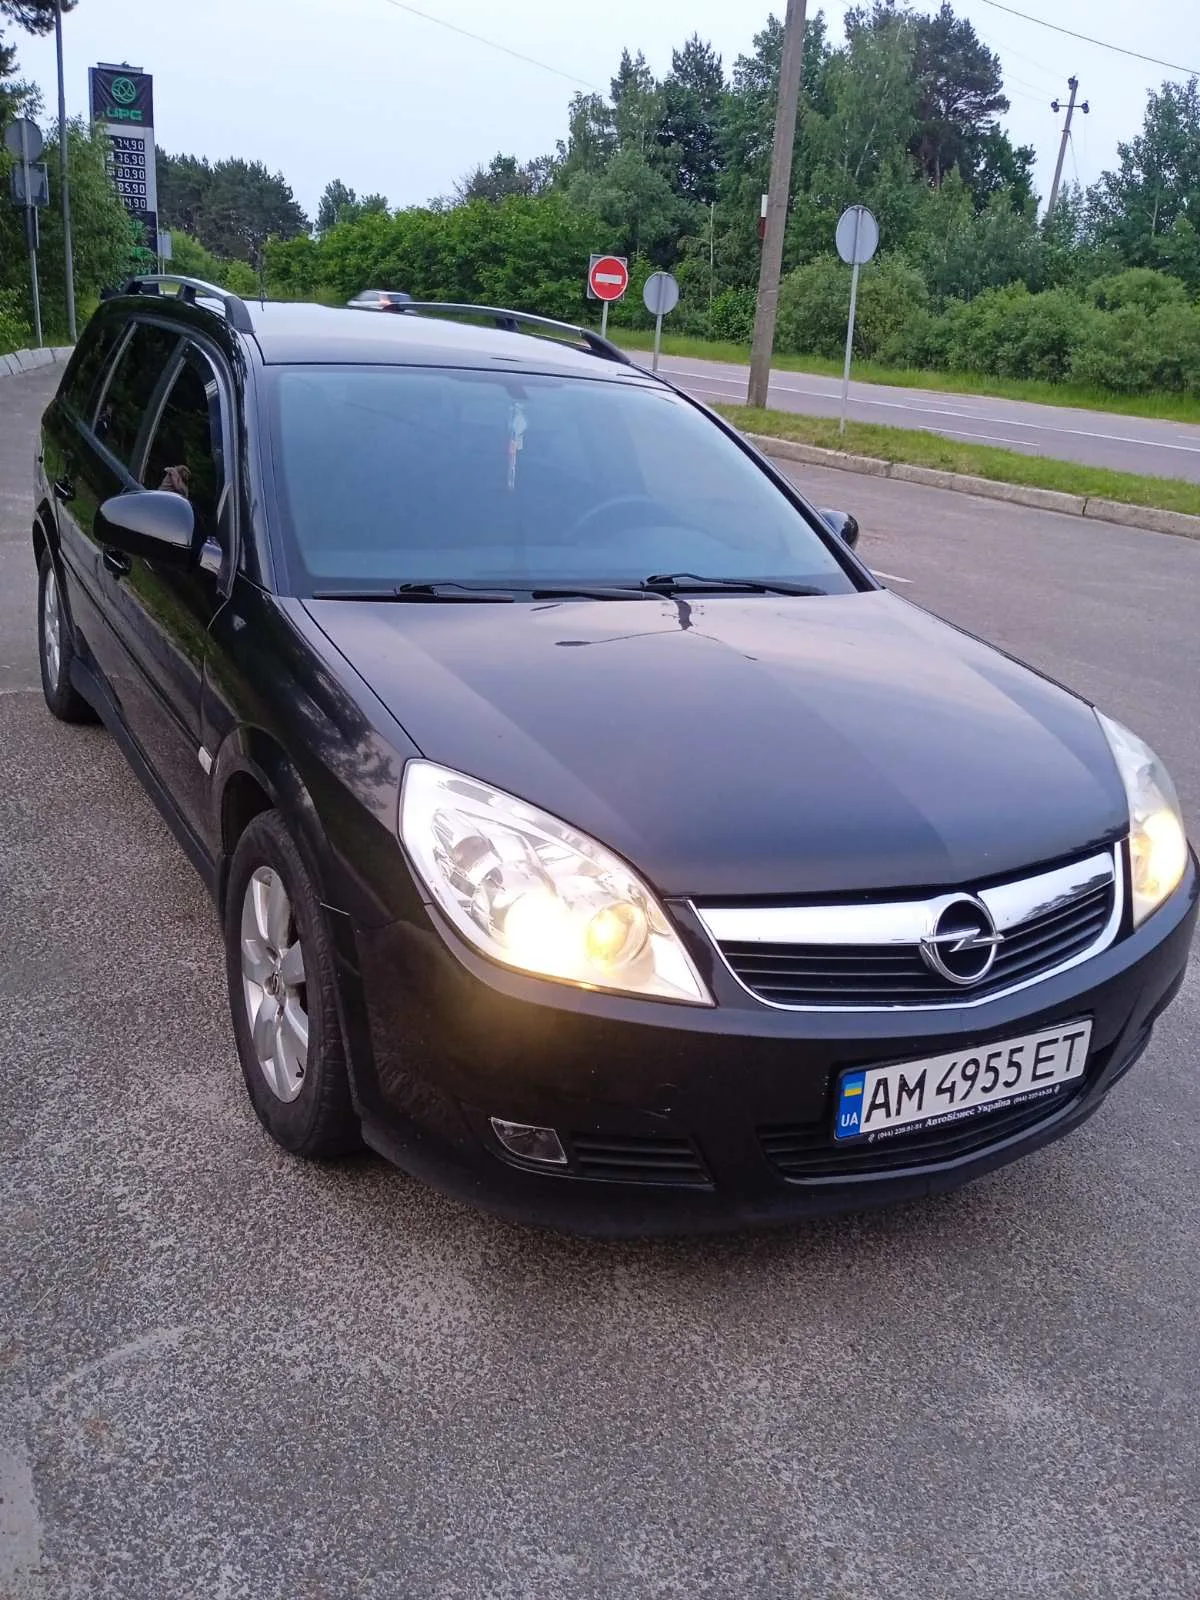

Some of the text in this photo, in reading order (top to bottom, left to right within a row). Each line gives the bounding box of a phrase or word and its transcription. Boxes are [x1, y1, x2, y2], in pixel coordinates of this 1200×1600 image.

[118, 182, 145, 193] 85.90
[864, 1031, 1085, 1123] AM 4955 ET
[840, 1112, 858, 1127] UA
